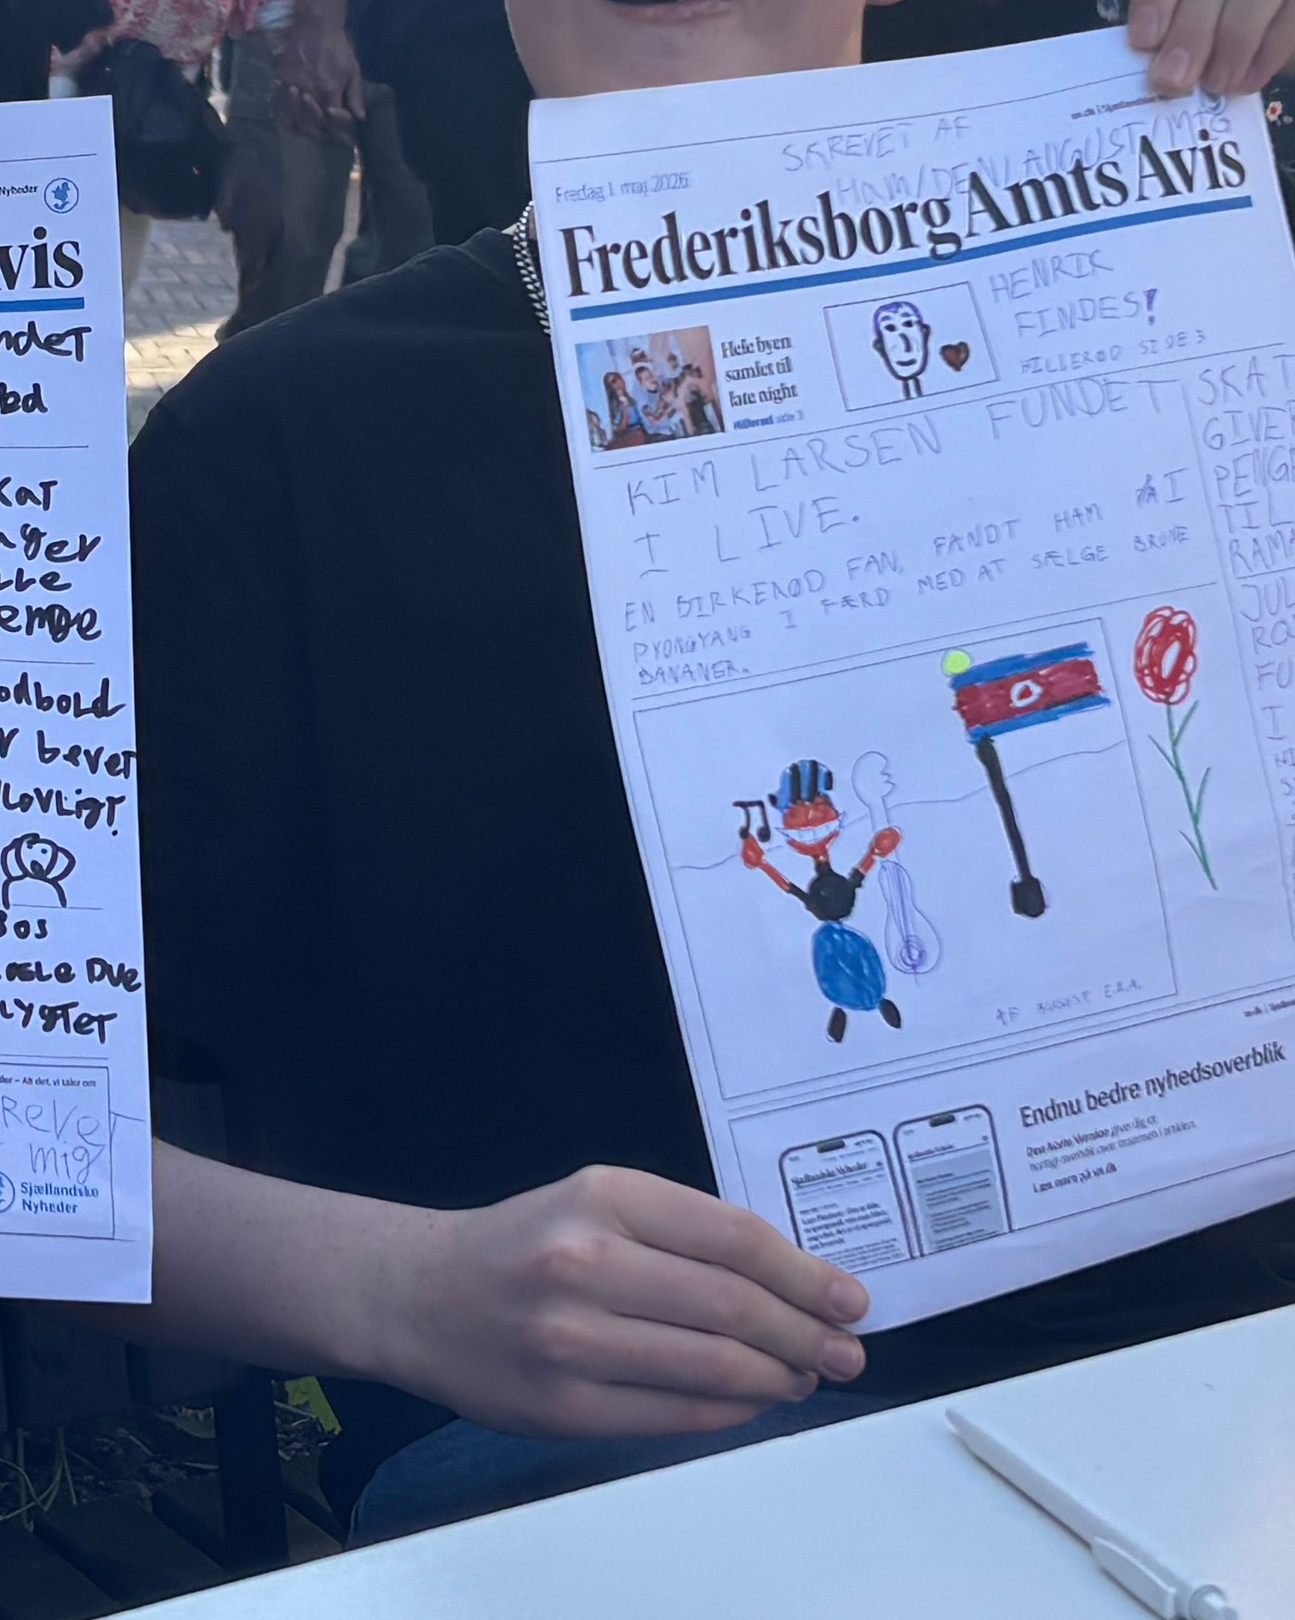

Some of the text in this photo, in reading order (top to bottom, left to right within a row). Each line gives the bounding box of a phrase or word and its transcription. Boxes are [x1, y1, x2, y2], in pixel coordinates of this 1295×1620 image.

[559, 128, 1247, 297] Frederiksborg Amts Avis
[756, 335, 792, 356] byen
[759, 382, 798, 405] night
[626, 377, 1180, 516] KIM LARSEN FUNDET
[714, 494, 861, 564] LIVE.
[623, 599, 656, 633] EN
[932, 518, 1021, 557] FANDT
[1053, 501, 1104, 533] HAM
[917, 568, 965, 595] MED
[978, 559, 1007, 585] AT
[1019, 1040, 1287, 1129] Endnu bedre nyhedsoverblik
[22, 1198, 79, 1215] Nyheder
